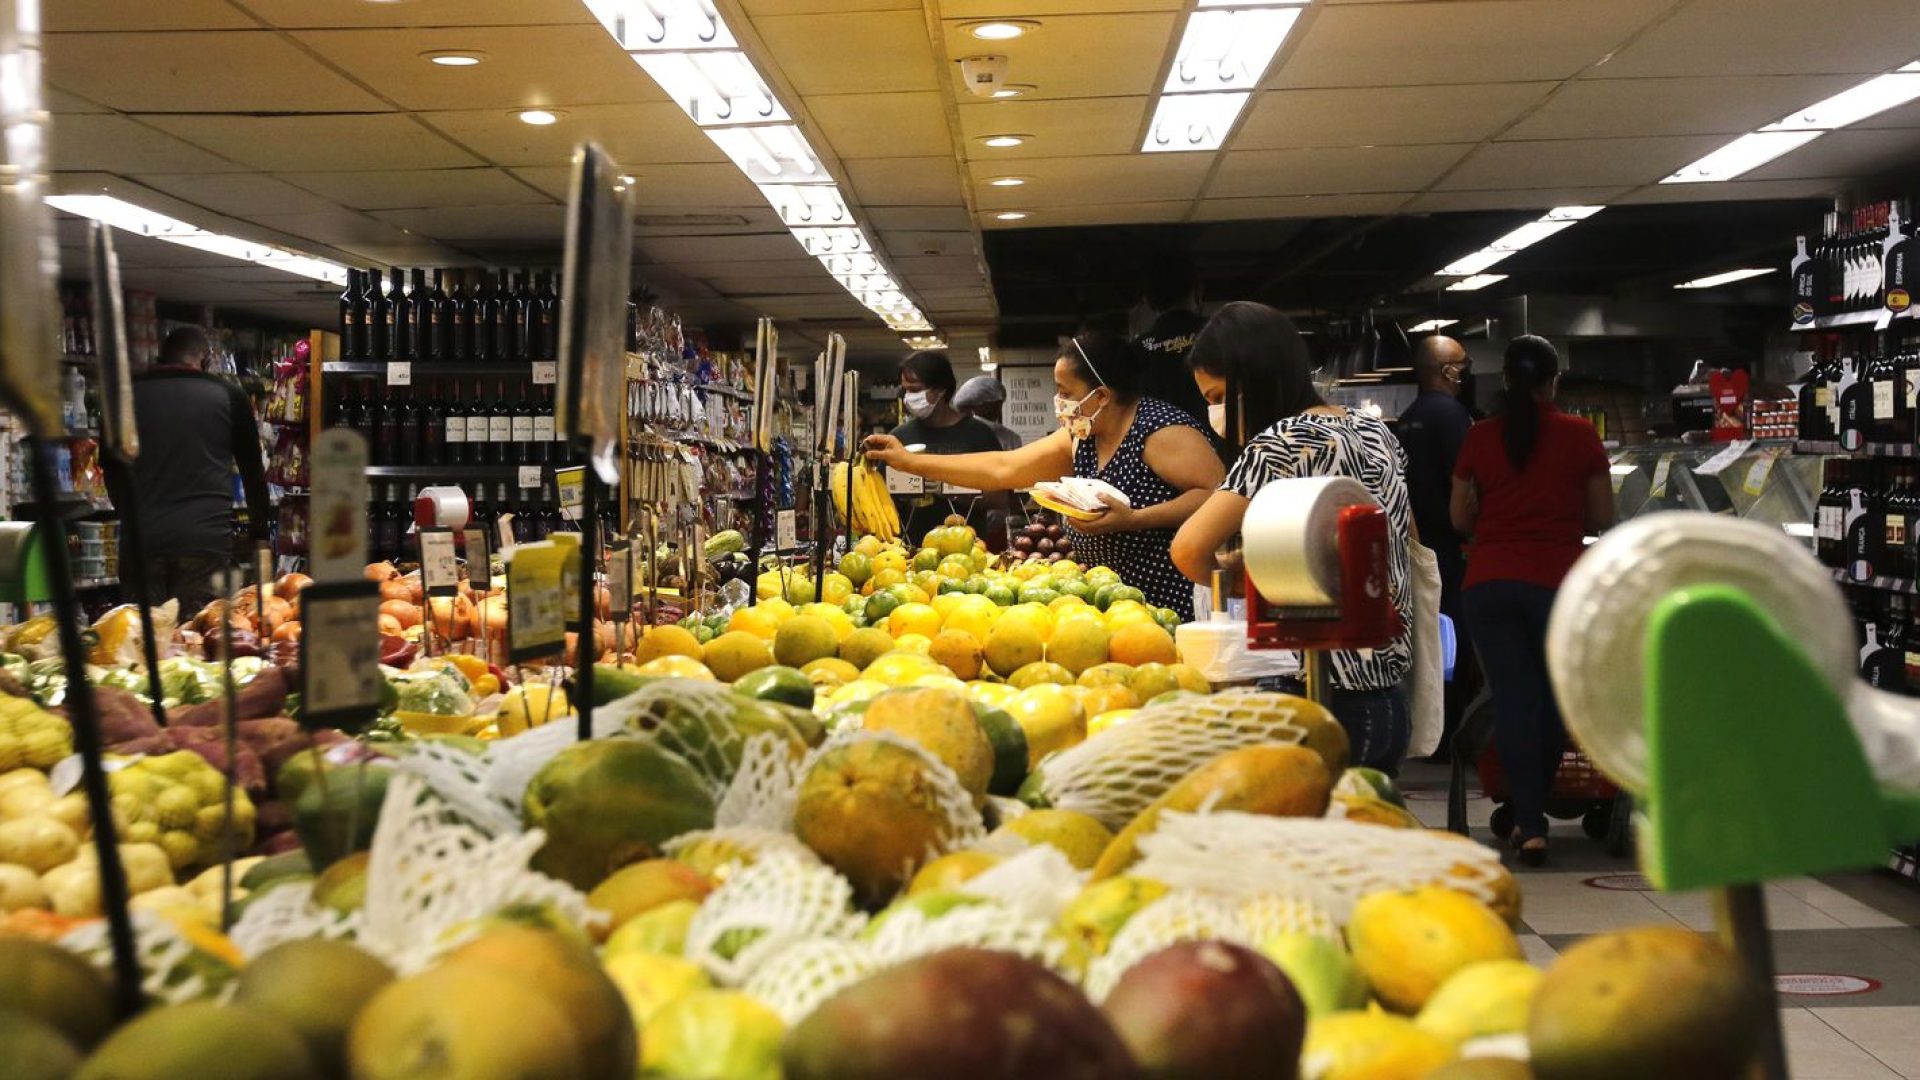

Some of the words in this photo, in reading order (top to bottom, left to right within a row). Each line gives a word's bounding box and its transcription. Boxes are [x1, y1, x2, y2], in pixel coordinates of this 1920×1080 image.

[1798, 273, 1806, 296] ÁFRICA
[1806, 287, 1813, 297] DO
[1011, 378, 1025, 388] LEVE
[1027, 378, 1041, 387] UMA
[1011, 389, 1028, 400] PIZZA
[1011, 401, 1048, 413] QUENTINHA
[1011, 415, 1027, 425] PARA
[1029, 415, 1045, 425] CASA
[1857, 527, 1866, 554] FRANÇA
